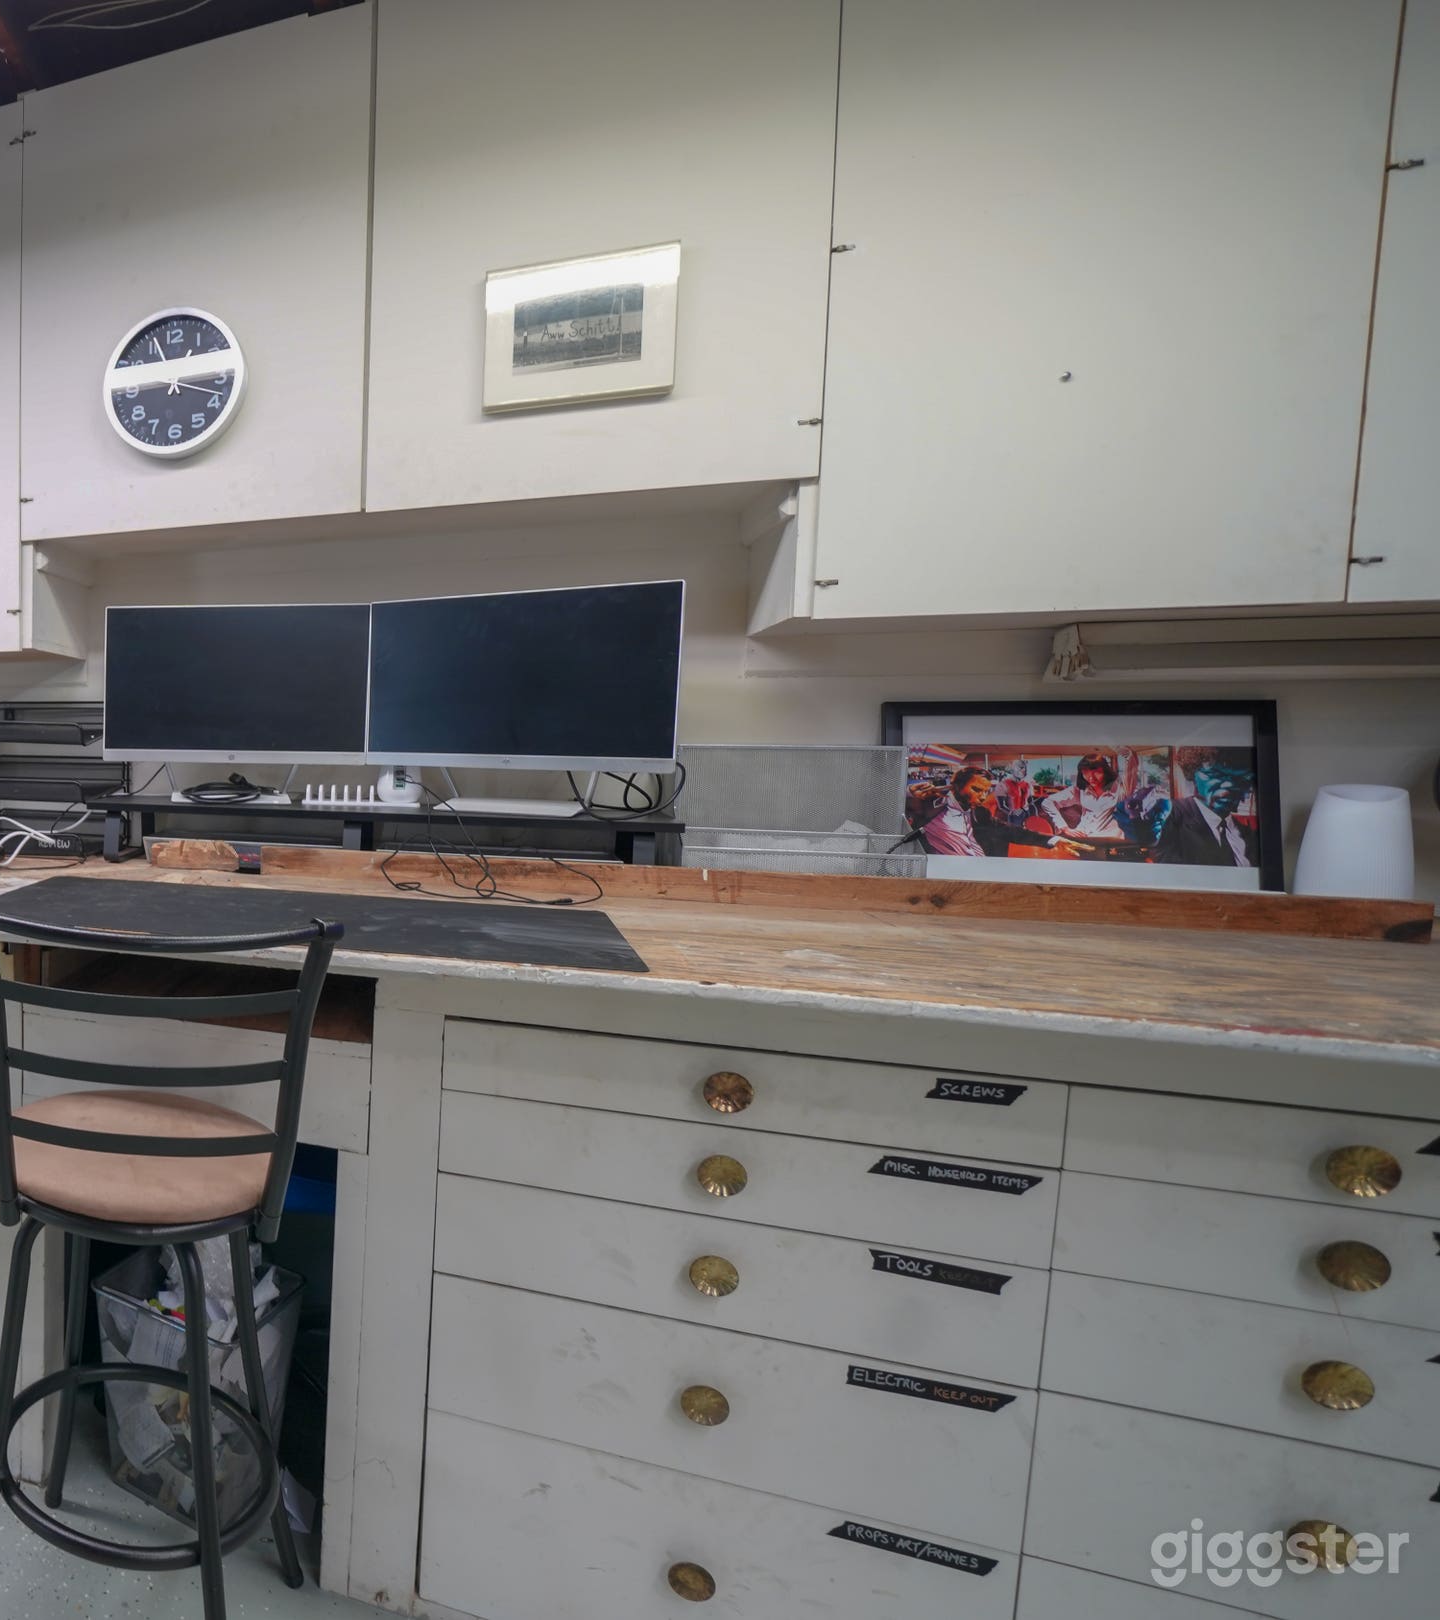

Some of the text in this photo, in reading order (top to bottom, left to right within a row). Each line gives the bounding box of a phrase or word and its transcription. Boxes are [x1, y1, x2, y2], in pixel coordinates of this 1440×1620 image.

[166, 328, 184, 344] 12
[196, 332, 201, 347] 1
[541, 323, 564, 344] Aww
[207, 395, 221, 409] 4
[131, 405, 146, 421] 8
[191, 413, 206, 428] 5
[148, 419, 160, 435] 7
[168, 424, 183, 439] 6
[939, 1082, 1006, 1099] SCREWS
[883, 1160, 920, 1175] MISC.
[991, 1174, 1029, 1189] ITEMS
[878, 1254, 934, 1276] TOOLS
[851, 1367, 999, 1407] ELECTRIC KEEP OUT
[846, 1523, 895, 1545] PROPS:
